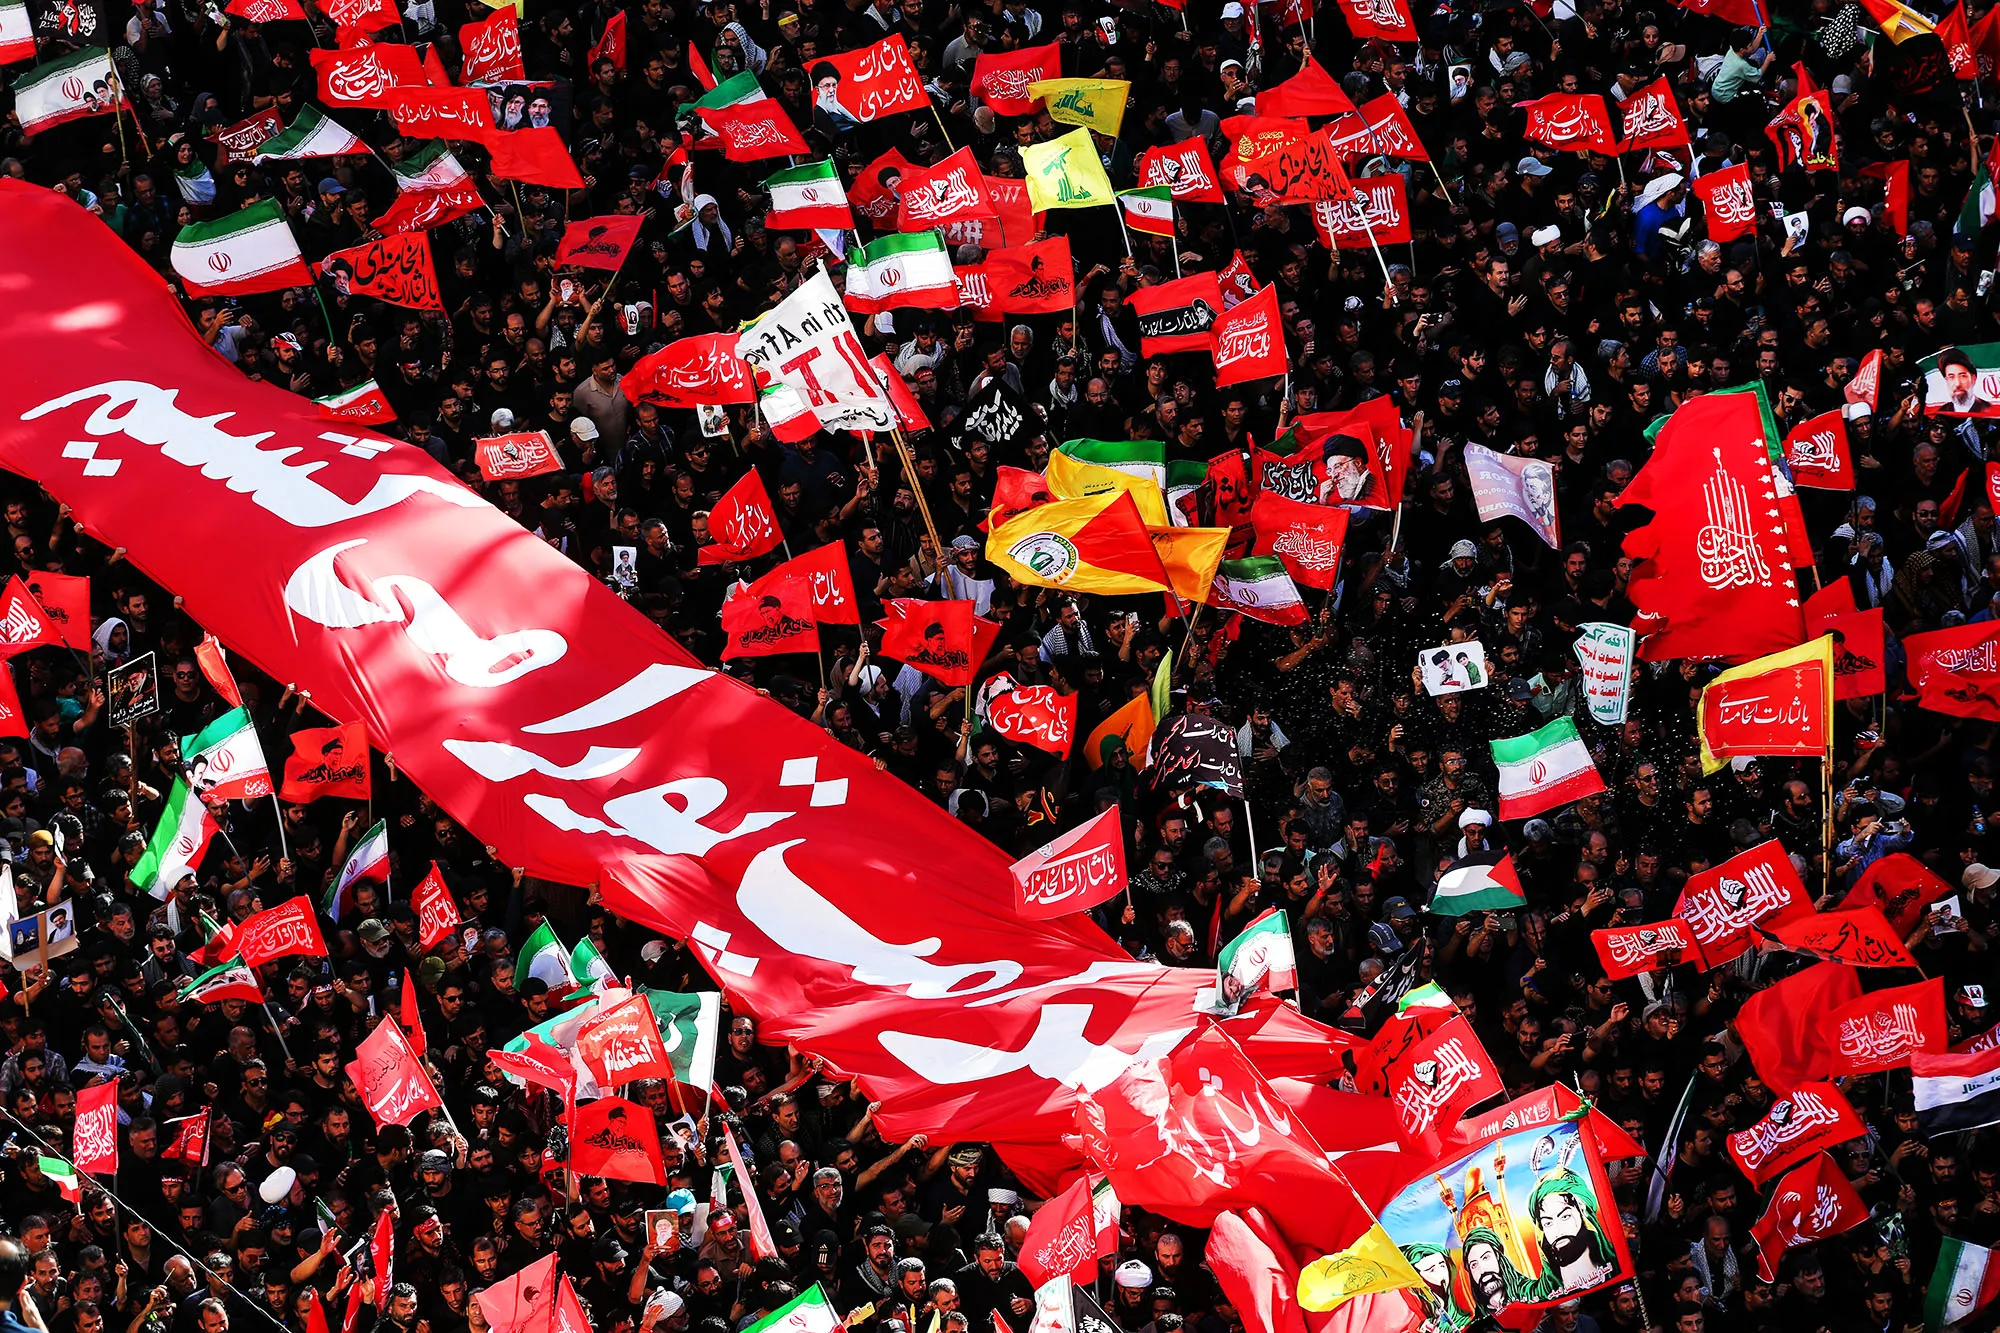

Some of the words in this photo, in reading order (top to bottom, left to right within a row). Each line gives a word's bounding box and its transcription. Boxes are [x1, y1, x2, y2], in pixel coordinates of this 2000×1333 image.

[1598, 653, 1625, 665] الموت
[1596, 670, 1623, 682] الموت
[129, 697, 155, 714] شهرستان
[604, 1034, 657, 1081] انتقام
